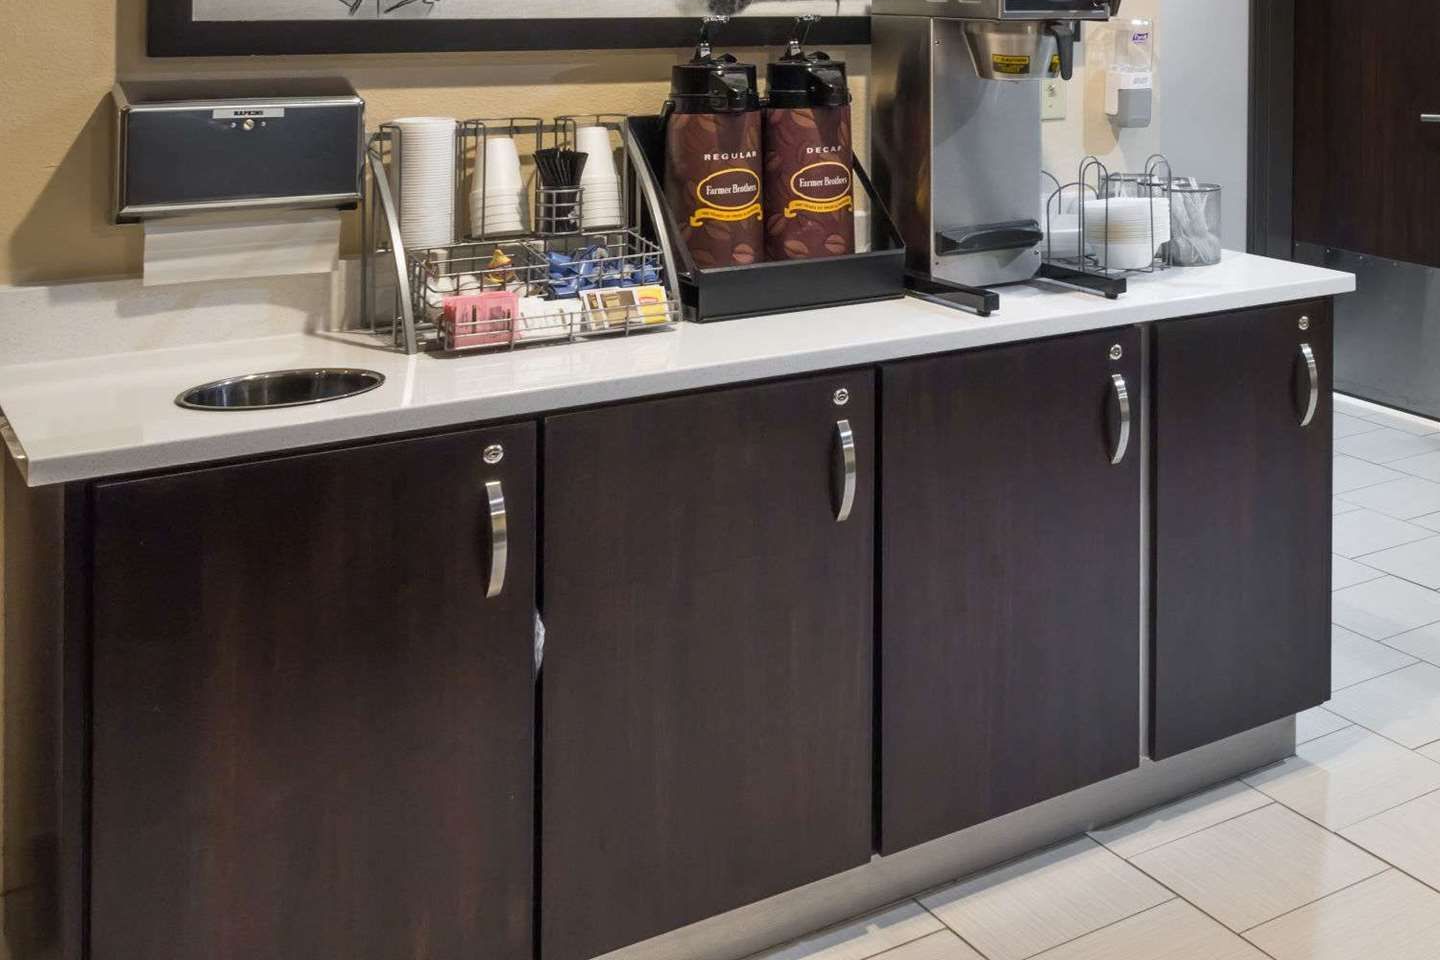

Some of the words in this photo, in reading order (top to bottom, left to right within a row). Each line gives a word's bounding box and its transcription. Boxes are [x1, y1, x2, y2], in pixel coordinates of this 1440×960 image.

[704, 150, 757, 161] REGULAR
[800, 178, 823, 188] Farmer
[824, 176, 847, 186] Brothers
[706, 185, 732, 196] Farmer
[732, 183, 757, 194] Brothers
